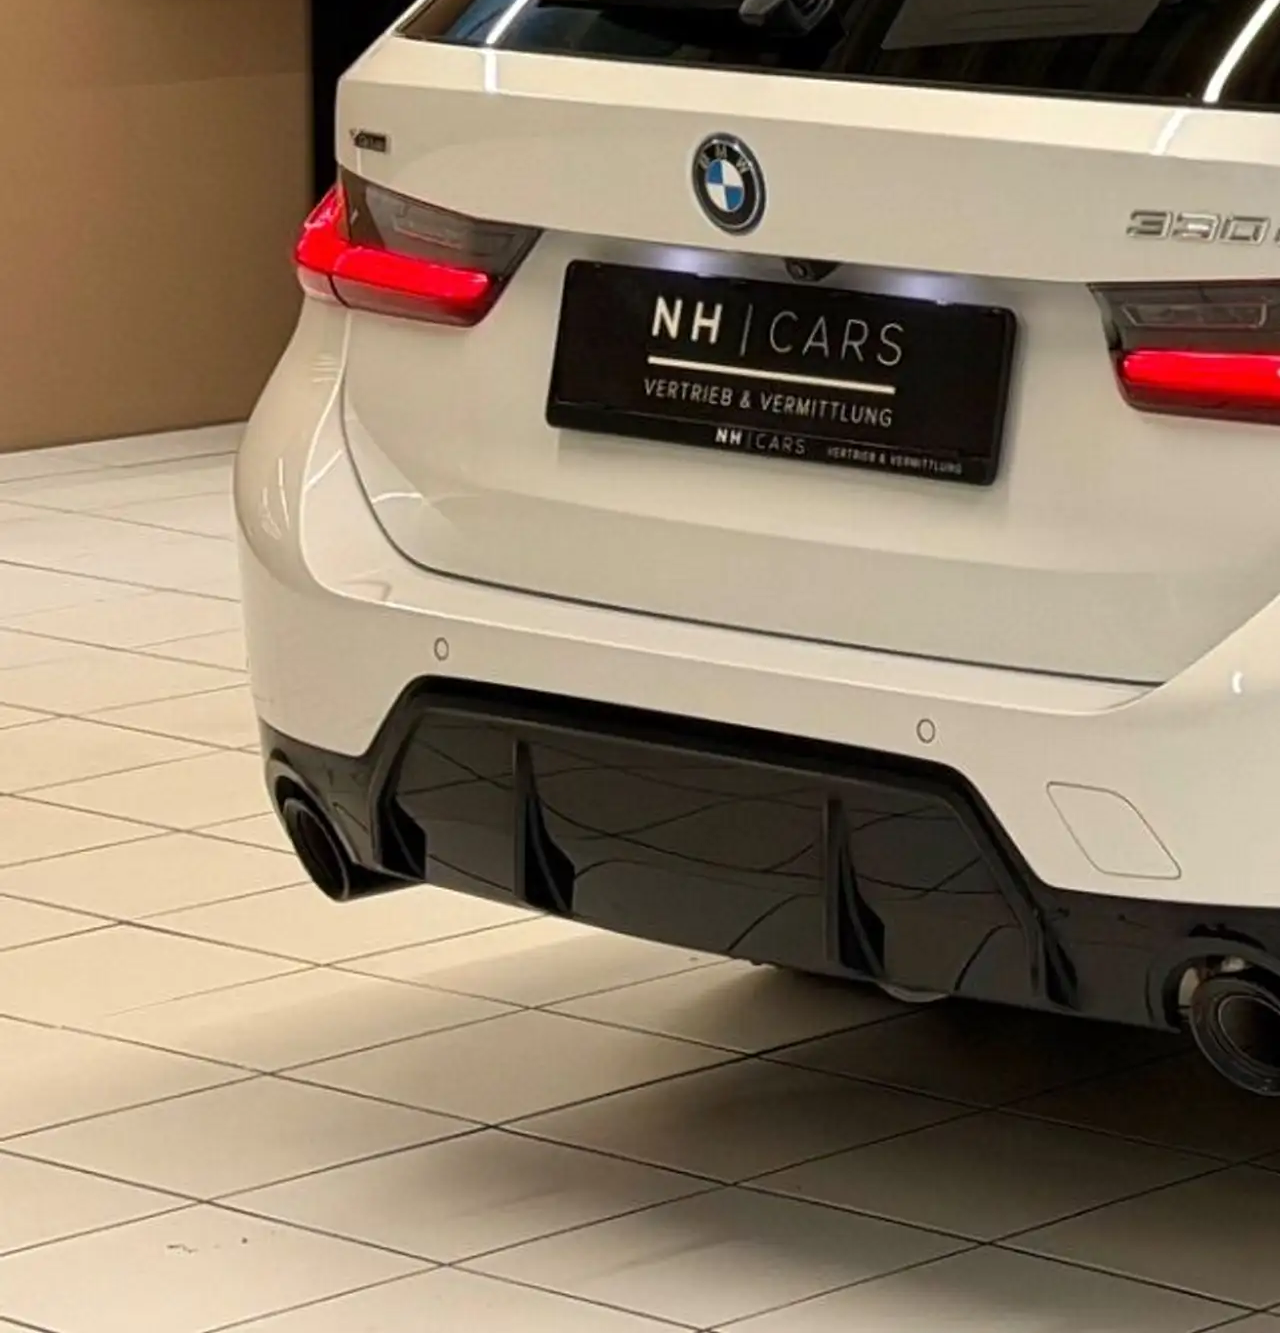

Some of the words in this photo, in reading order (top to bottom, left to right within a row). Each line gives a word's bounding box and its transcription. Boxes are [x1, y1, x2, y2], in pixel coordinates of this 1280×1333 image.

[651, 296, 724, 345] NH
[769, 311, 906, 367] CARS
[644, 378, 734, 408] VERTRIEB
[740, 392, 751, 410] &
[760, 395, 893, 428] VERMITTLUNG
[715, 428, 743, 446] NH
[755, 433, 806, 455] CARS
